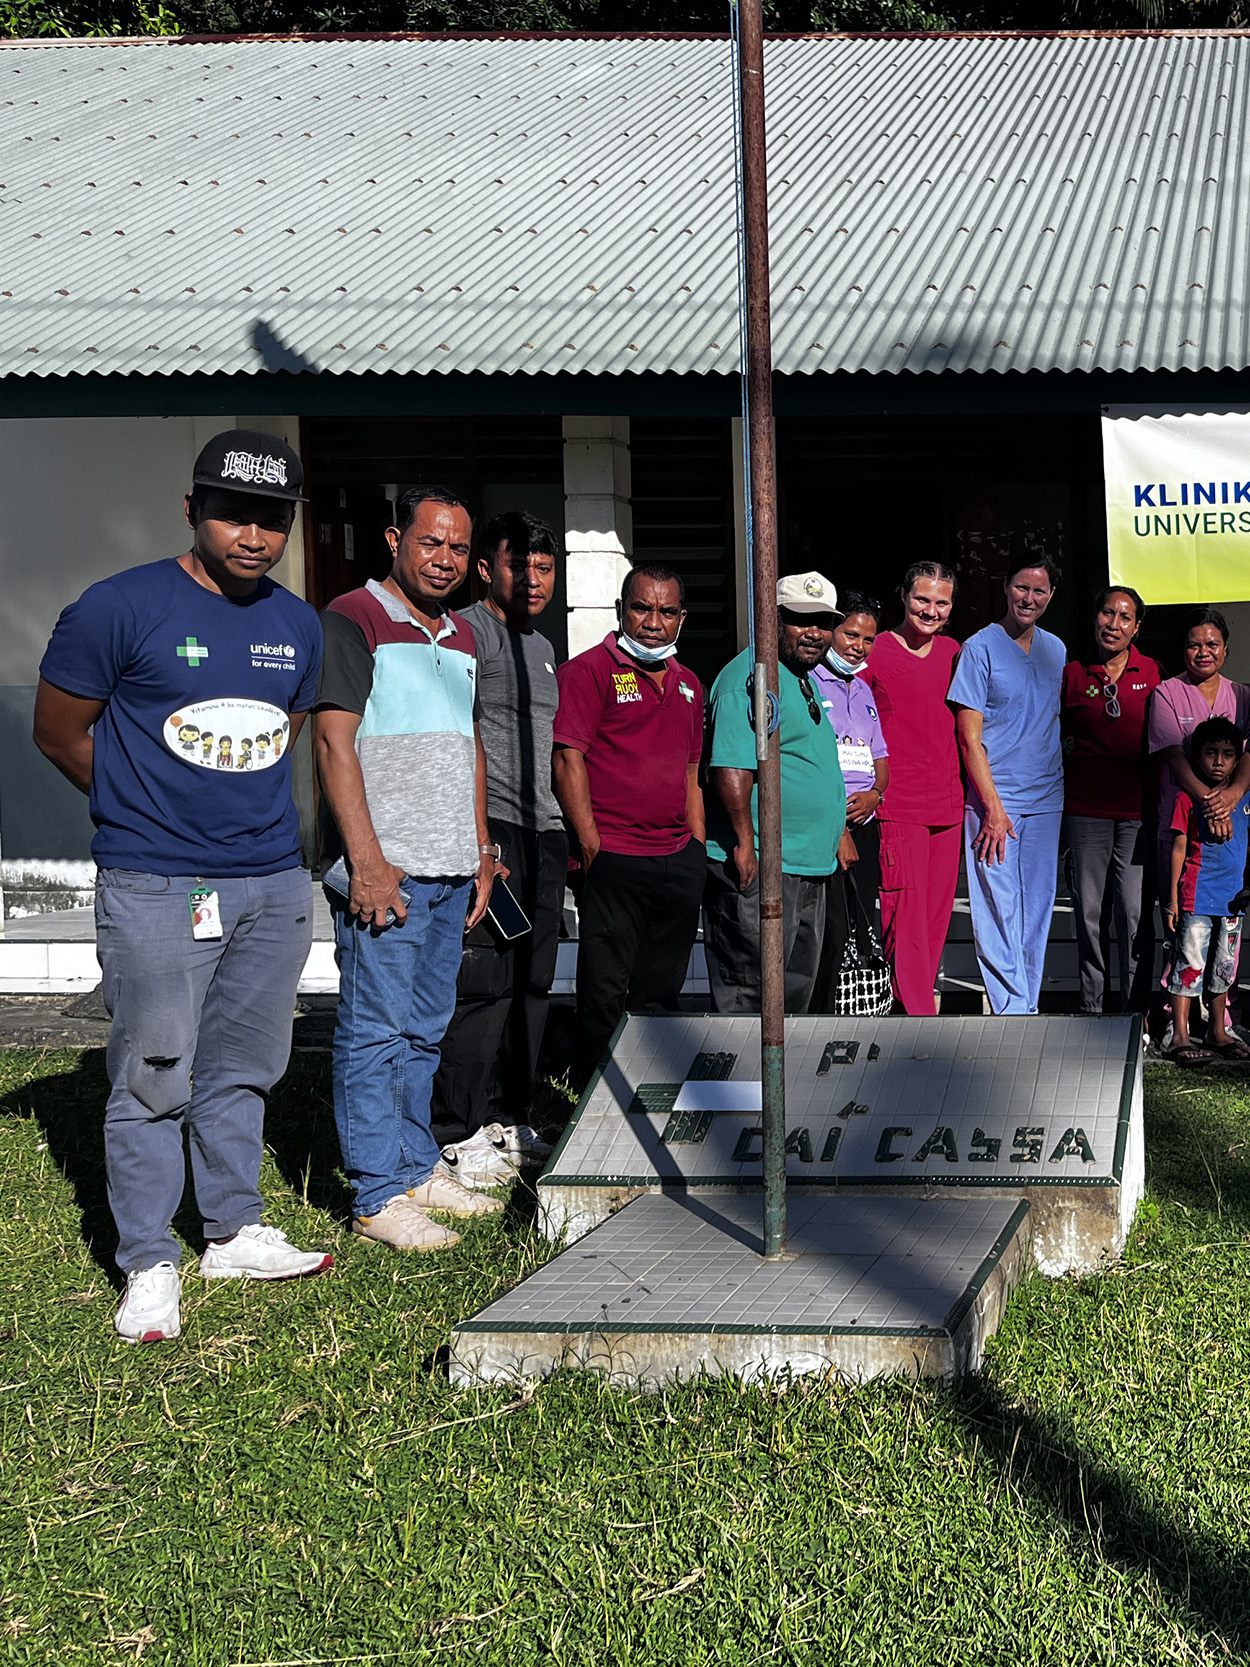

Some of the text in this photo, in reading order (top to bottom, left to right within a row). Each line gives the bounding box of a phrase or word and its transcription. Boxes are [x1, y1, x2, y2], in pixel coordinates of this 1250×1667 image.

[250, 642, 283, 656] unicef
[251, 659, 262, 667] for
[263, 661, 281, 670] every
[612, 672, 637, 684] TURN
[616, 692, 643, 704] HEALTH
